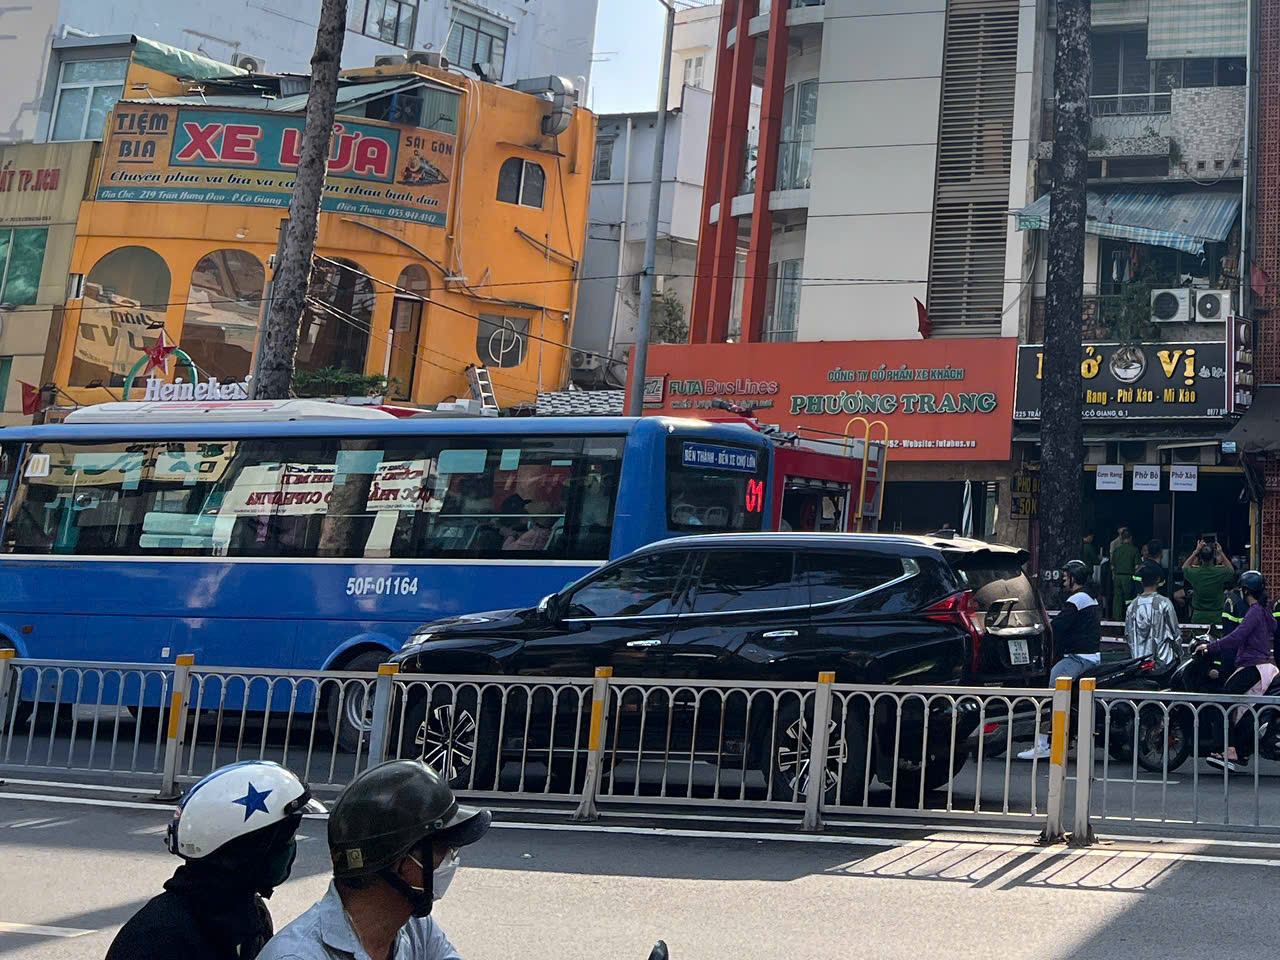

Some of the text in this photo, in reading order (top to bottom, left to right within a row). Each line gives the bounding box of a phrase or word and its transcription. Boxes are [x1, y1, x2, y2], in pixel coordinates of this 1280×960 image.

[117, 110, 168, 135] TIỆM
[119, 140, 156, 158] BIA
[176, 122, 263, 164] XE
[227, 173, 252, 184] bia
[139, 190, 157, 199] 219
[254, 195, 282, 205] Giang
[828, 367, 854, 382] CÔNG
[857, 370, 869, 382] TY
[915, 369, 929, 381] XE
[929, 365, 965, 380] KHÁCH
[1157, 349, 1197, 386] Vị
[144, 377, 251, 401] Heineken
[669, 379, 703, 395] FUTA
[704, 379, 779, 395] BusLines
[1086, 390, 1108, 406] Rang
[1117, 387, 1133, 403] Phở
[789, 391, 898, 415] PHƯƠNG
[900, 392, 997, 414] TRANG
[1134, 471, 1149, 479] Phở
[745, 478, 764, 513] 01
[346, 577, 418, 596] 50F-01164
